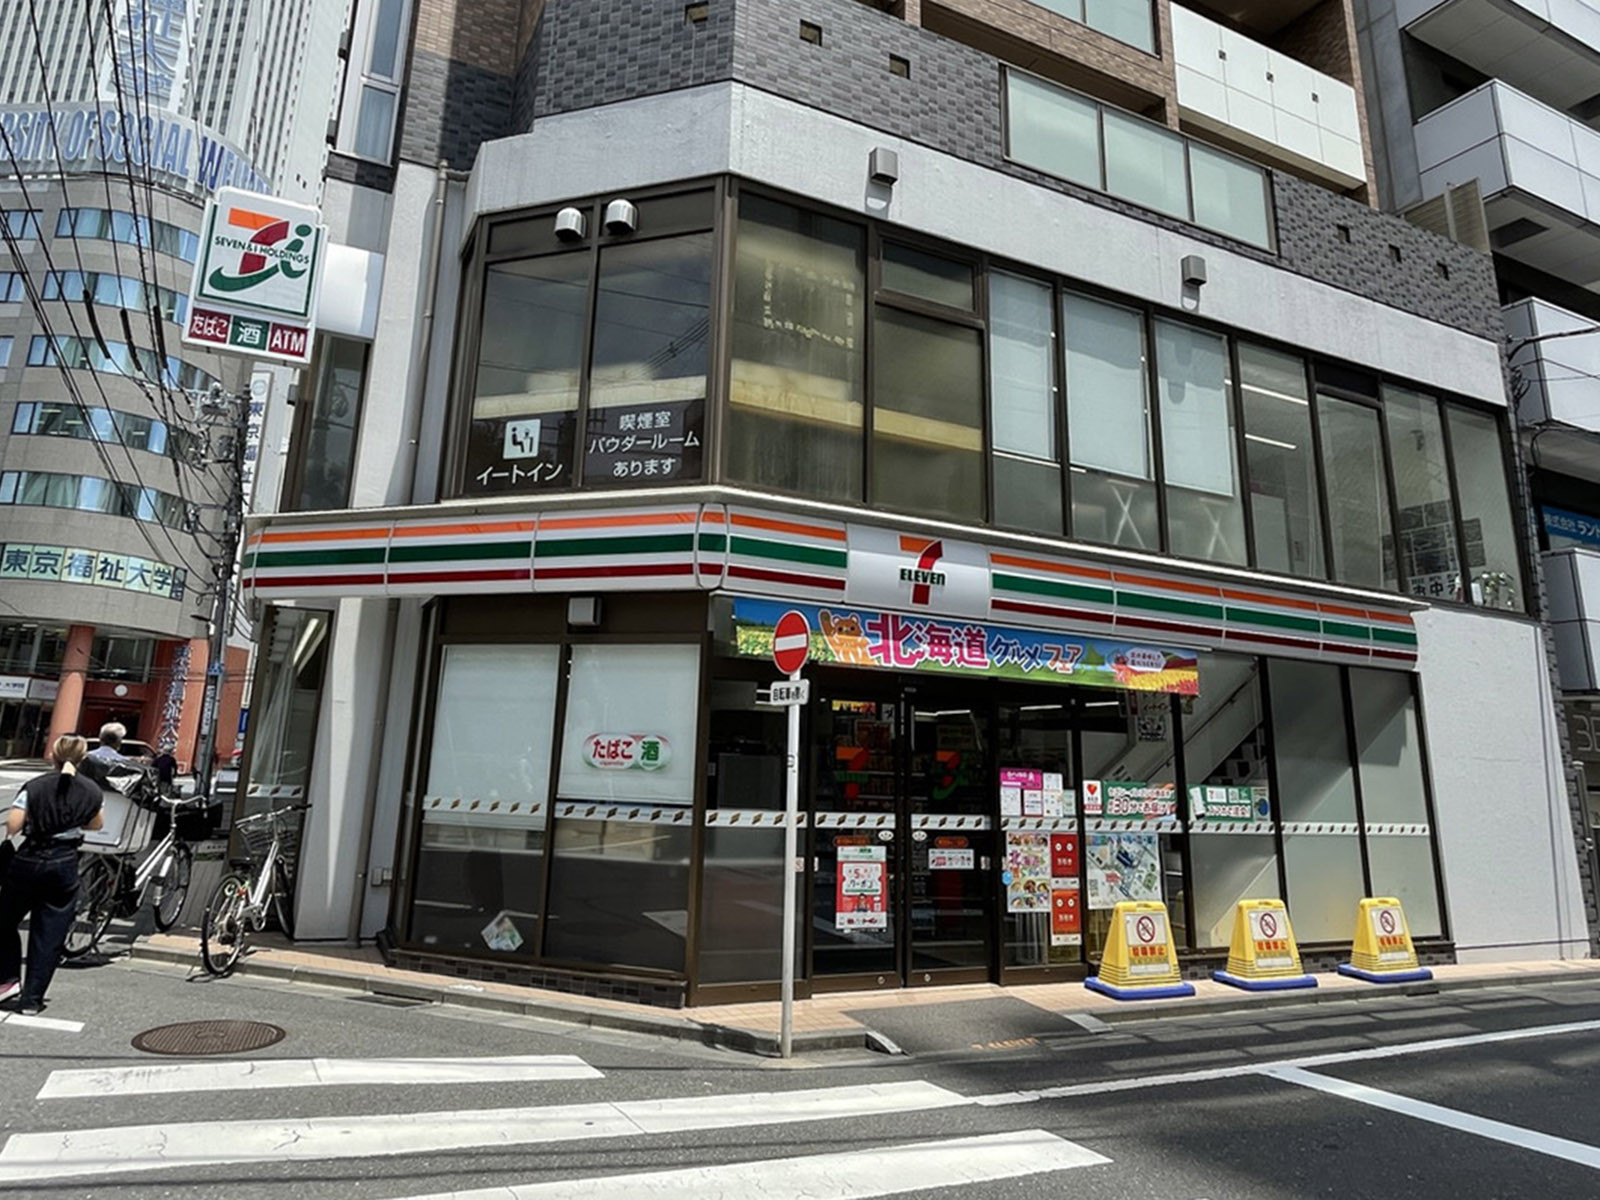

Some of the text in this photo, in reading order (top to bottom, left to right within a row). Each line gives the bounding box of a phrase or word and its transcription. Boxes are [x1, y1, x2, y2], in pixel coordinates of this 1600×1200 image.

[64, 110, 98, 160] OF
[96, 110, 193, 178] SOCIAL
[260, 246, 310, 264] HOLDINGS
[191, 315, 228, 338] たばこ
[237, 321, 262, 344] 酒
[271, 329, 304, 352] ATM
[619, 410, 672, 431] 喫煙室
[589, 431, 700, 454] パウダールーム
[476, 463, 563, 485] イートイン
[613, 458, 676, 477] あります
[3, 548, 172, 591] 東京福祉大学
[592, 739, 633, 759] たばこ
[641, 741, 659, 761] 酒
